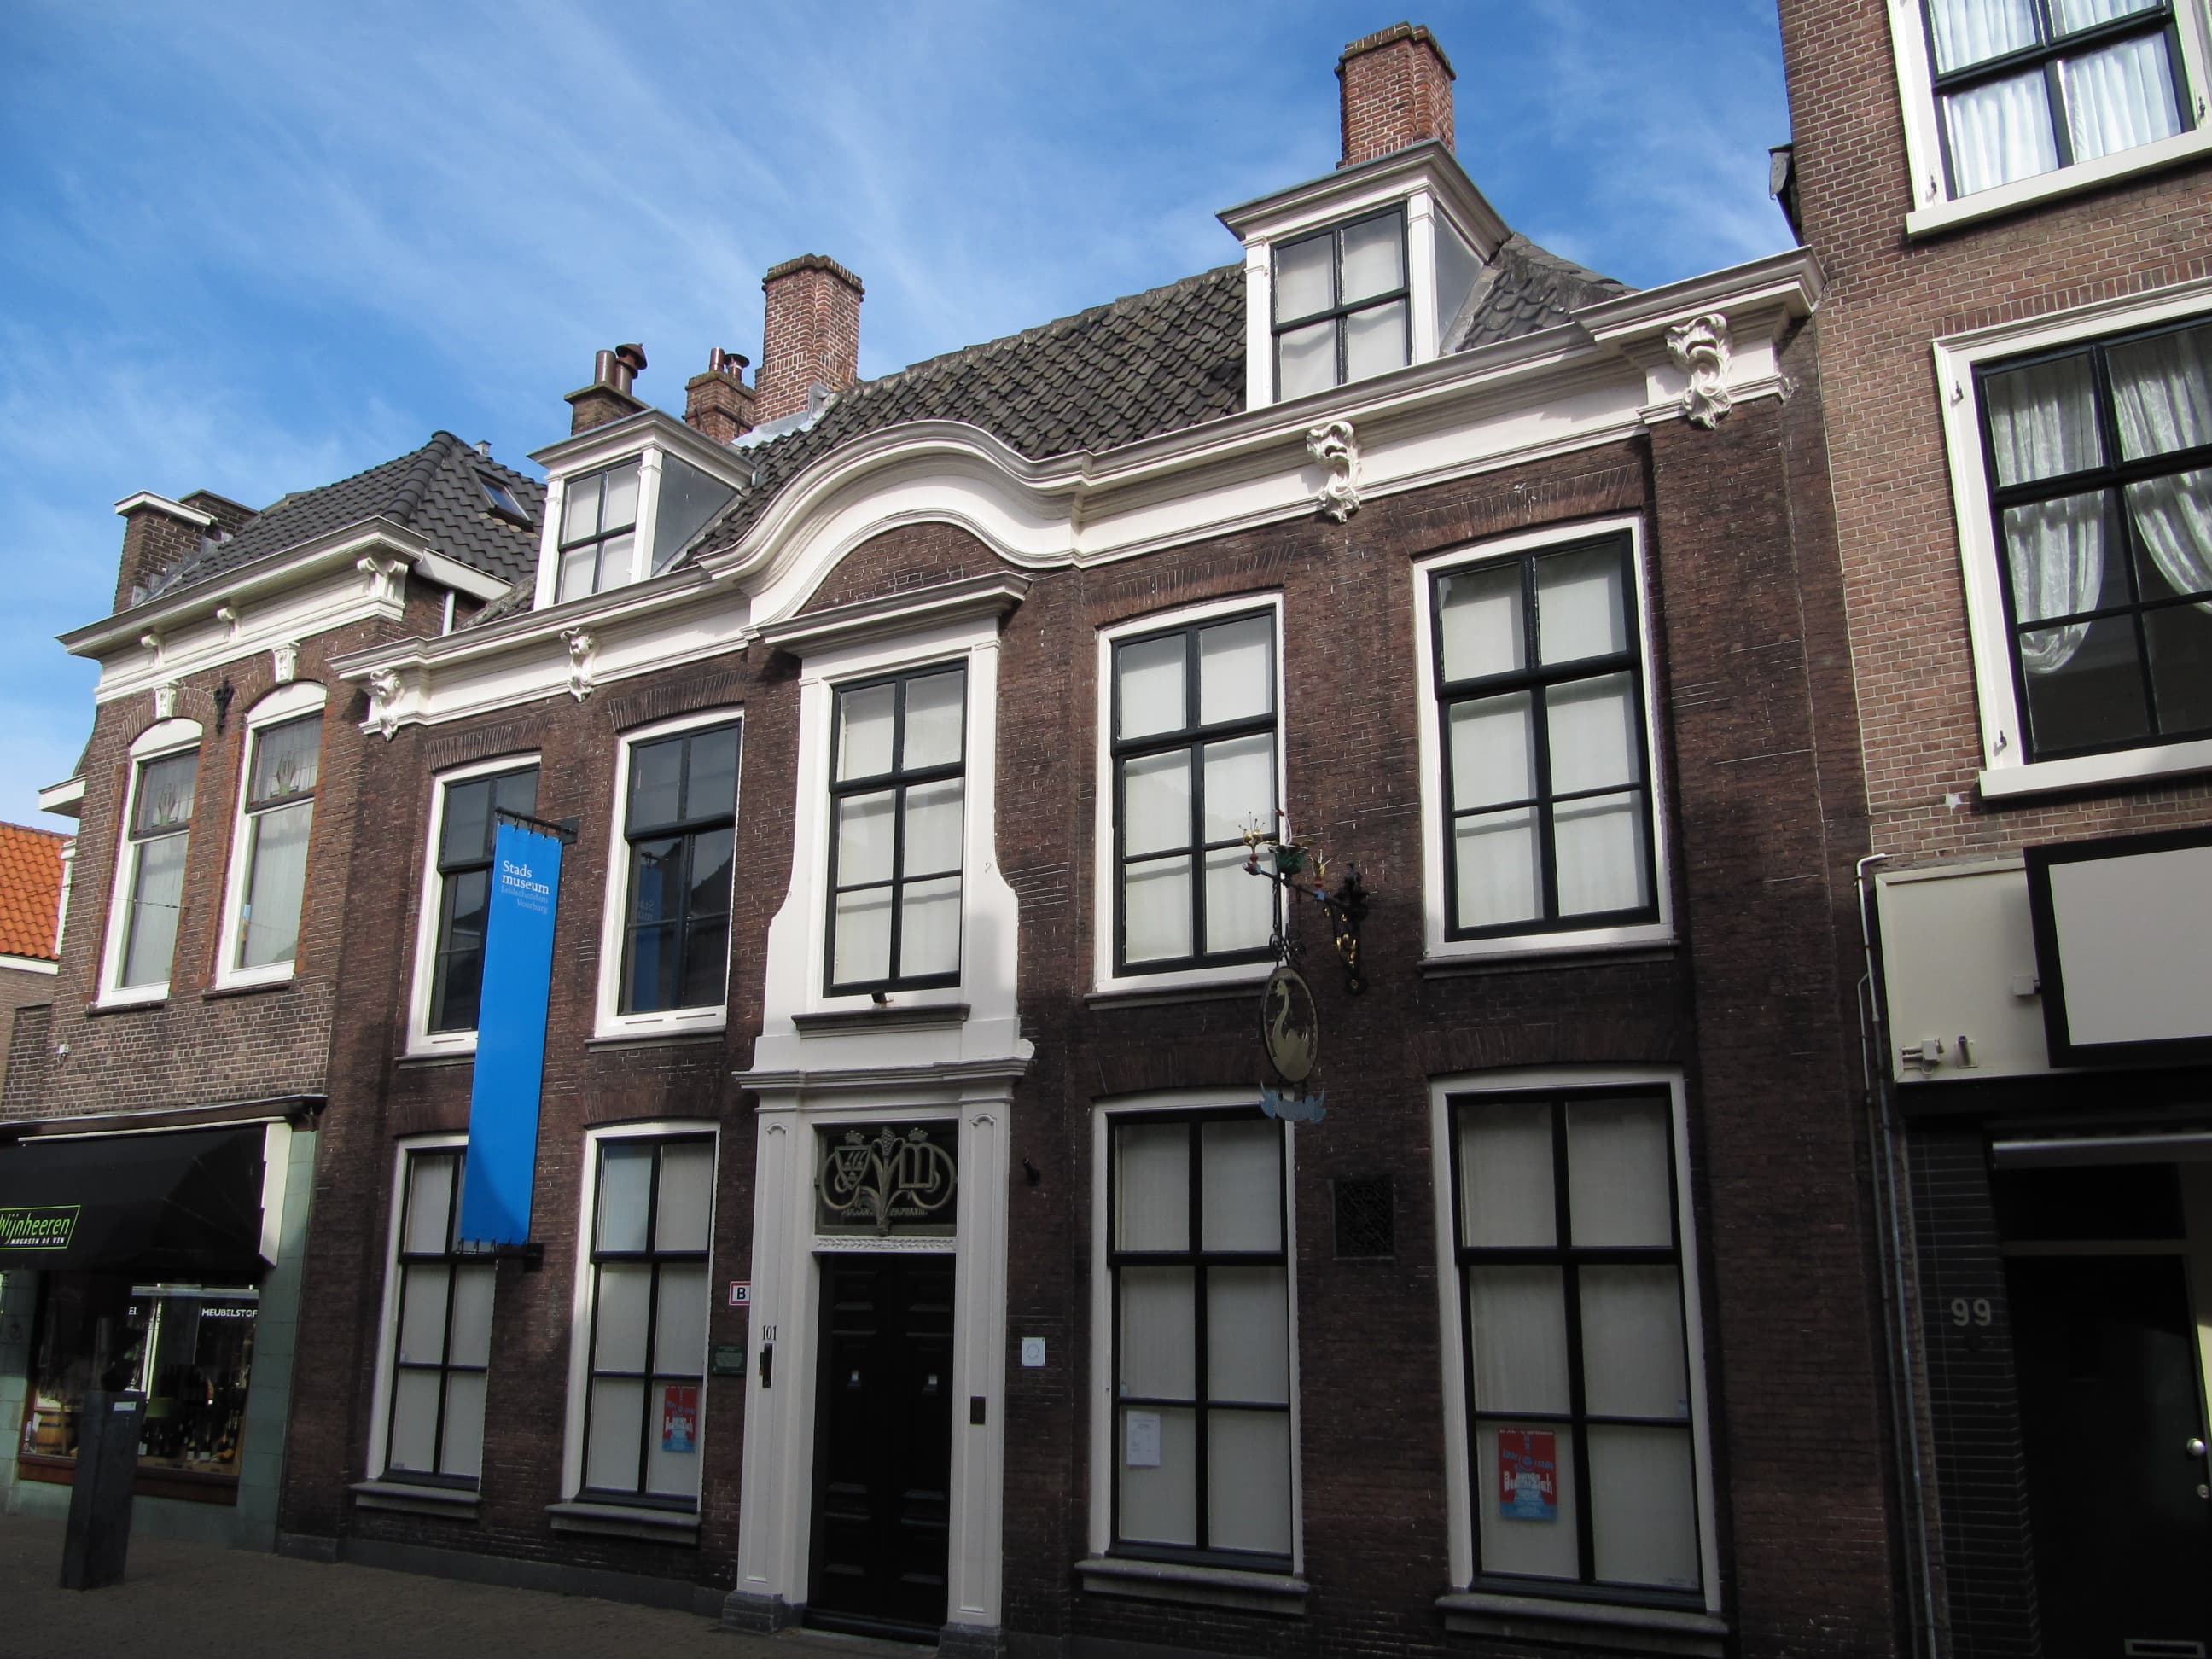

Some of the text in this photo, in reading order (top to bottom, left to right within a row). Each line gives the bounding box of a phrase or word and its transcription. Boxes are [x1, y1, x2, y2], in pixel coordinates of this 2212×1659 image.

[503, 860, 533, 878] Stads
[502, 874, 549, 894] museum
[0, 1212, 71, 1244] Wijnheeren
[736, 1287, 746, 1300] B
[1951, 1297, 1991, 1326] 99
[762, 1324, 777, 1341] 101
